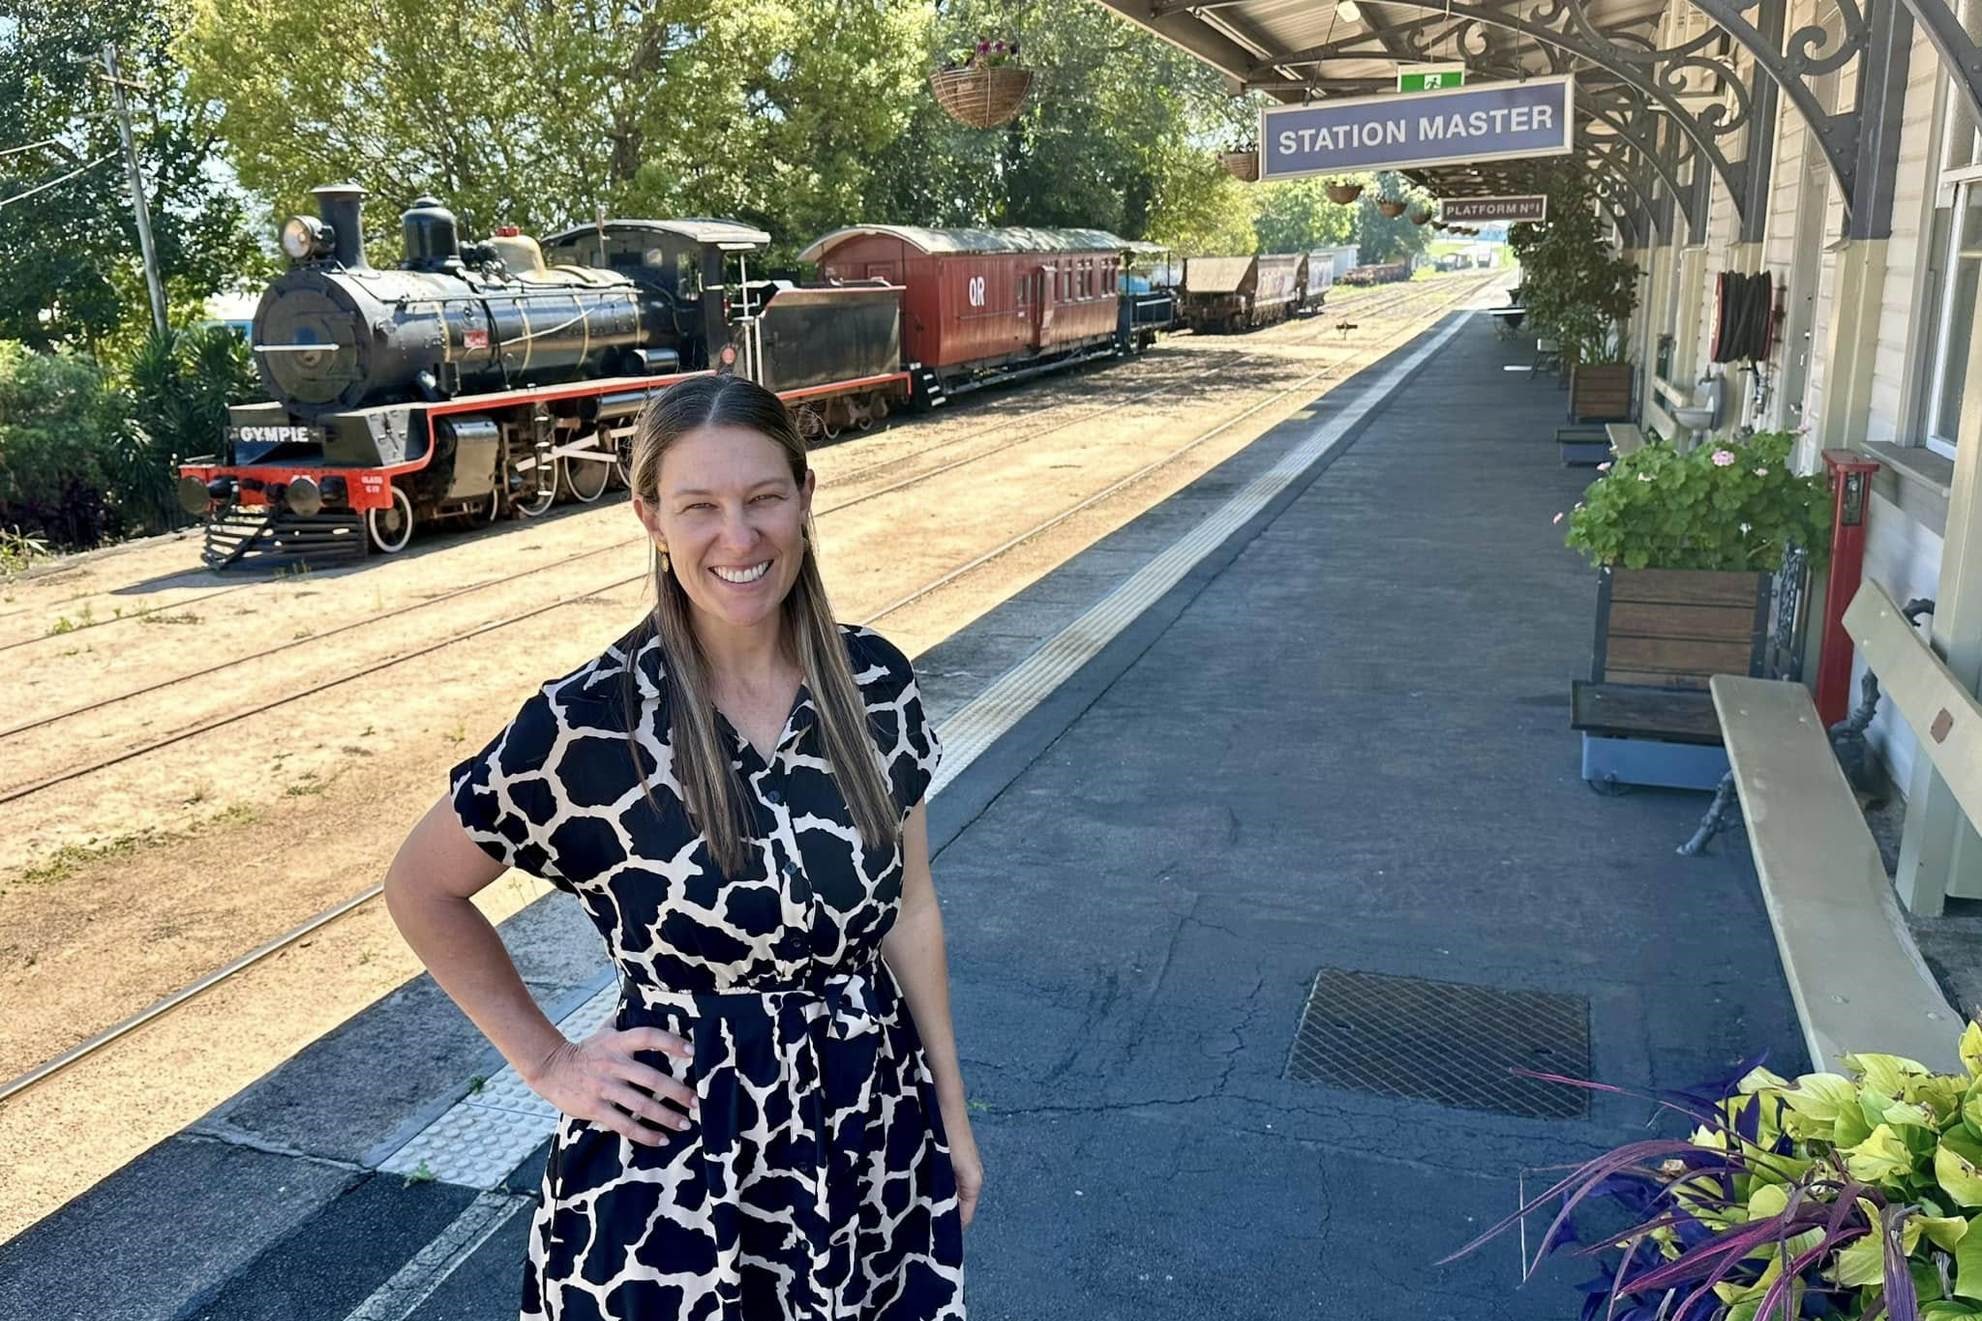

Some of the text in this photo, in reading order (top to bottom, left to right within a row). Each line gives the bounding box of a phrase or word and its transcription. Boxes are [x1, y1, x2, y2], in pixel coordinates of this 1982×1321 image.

[1279, 104, 1552, 155] STATION MASTER
[1446, 203, 1517, 216] PLATFORM
[969, 276, 985, 307] QR
[240, 426, 309, 442] GYMPIE
